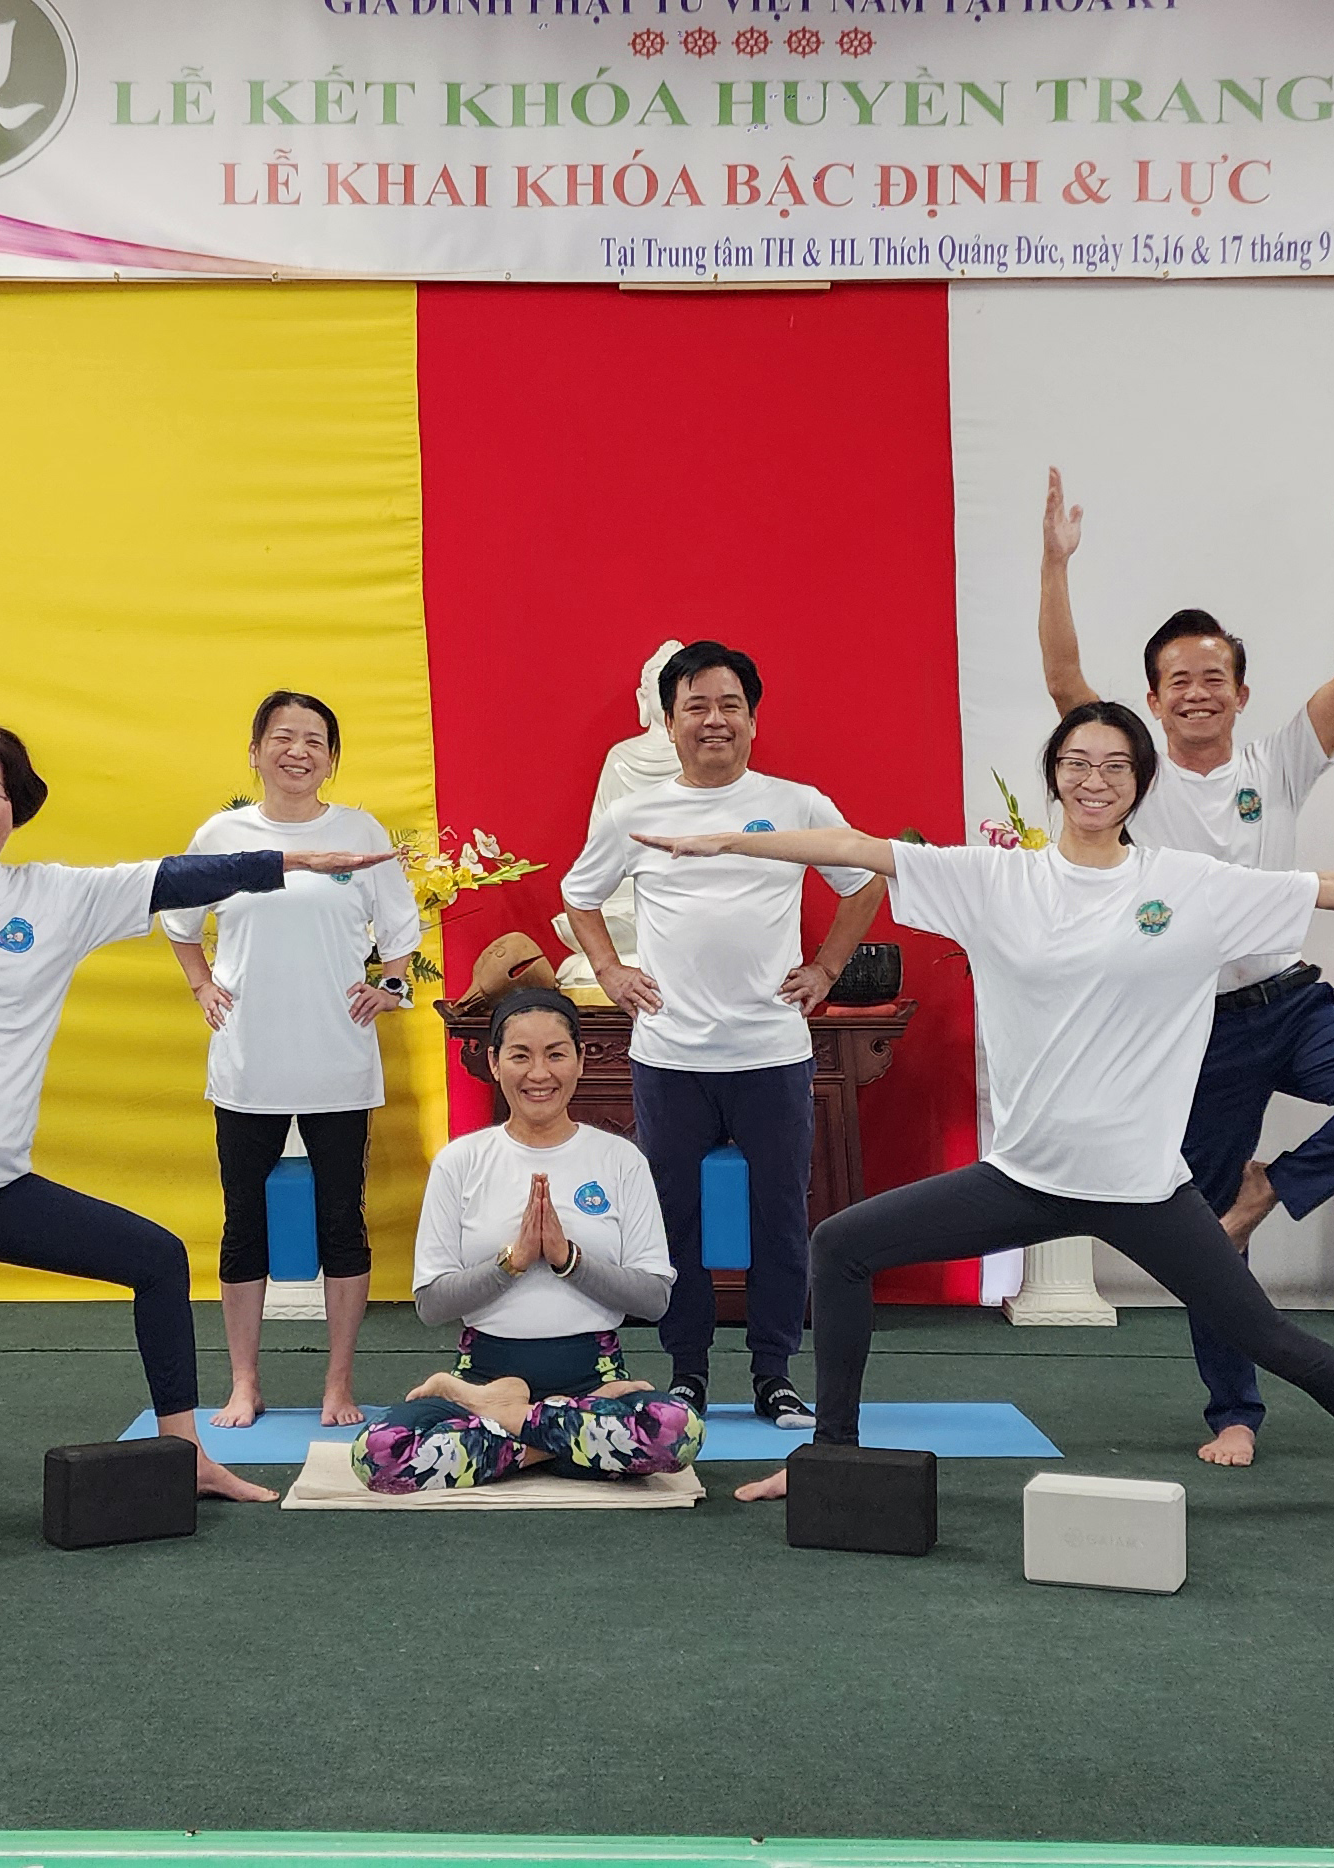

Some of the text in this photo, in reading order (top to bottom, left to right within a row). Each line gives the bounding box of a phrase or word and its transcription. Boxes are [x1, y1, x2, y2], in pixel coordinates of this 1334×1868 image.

[108, 66, 217, 126] LỄ
[242, 65, 415, 126] KẾT
[440, 67, 691, 128] KHÓA
[712, 67, 1009, 127] HUYỀN
[219, 148, 1272, 219] LỄ KHAI KHÓA BẬC ĐỊNH & LỰC
[600, 237, 635, 275] Tại
[642, 238, 707, 275] Trung
[713, 236, 754, 267] tâm
[760, 237, 794, 267] TH
[802, 237, 822, 267] &
[829, 238, 865, 267] HL
[869, 235, 930, 267] Thích
[937, 234, 1009, 274] Quảng
[1014, 234, 1065, 270] Đức,
[1072, 236, 1123, 273] ngày
[1131, 234, 1185, 270] 15,16
[1191, 236, 1211, 265] &
[1220, 235, 1243, 265] 17
[1251, 232, 1313, 271] tháng
[1319, 231, 1332, 263] 9
